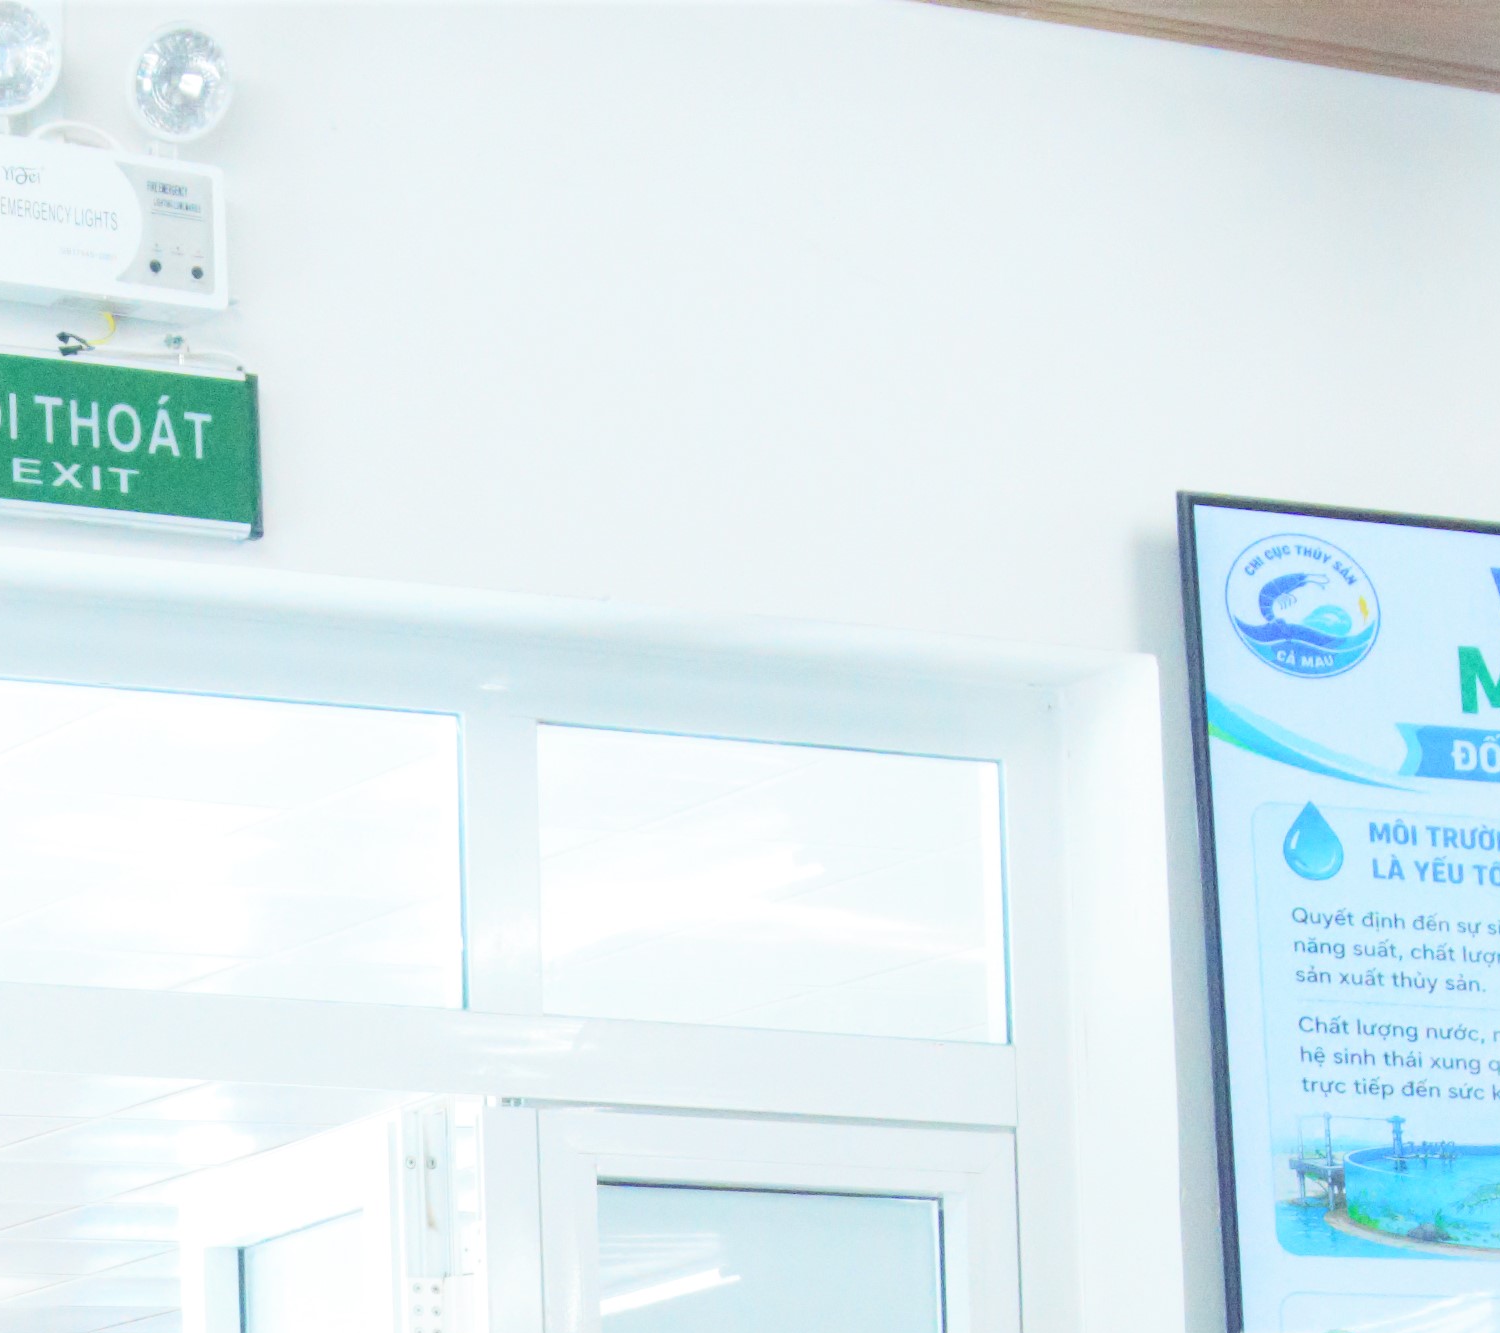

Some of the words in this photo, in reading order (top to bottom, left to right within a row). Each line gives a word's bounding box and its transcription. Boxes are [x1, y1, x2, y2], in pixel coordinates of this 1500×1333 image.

[0, 195, 72, 225] EMERGENCY
[73, 207, 119, 232] LIGHTS
[34, 394, 212, 459] THOÁT
[12, 457, 140, 494] EXIT
[1243, 555, 1265, 577] CHI
[1300, 655, 1335, 668] MAU
[1368, 819, 1419, 848] MÔI
[1371, 853, 1406, 882] LÀ
[1413, 856, 1465, 886] YẾU
[1290, 905, 1356, 931] Quyết
[1360, 910, 1407, 933] định
[1411, 914, 1452, 934] đến
[1456, 920, 1483, 939] sự
[1292, 936, 1347, 961] năng
[1352, 937, 1404, 963] suất,
[1409, 941, 1456, 963] chất
[1295, 964, 1333, 985] sản
[1338, 967, 1386, 988] xuất
[1390, 970, 1439, 995] thủy
[1444, 973, 1487, 993] sản.
